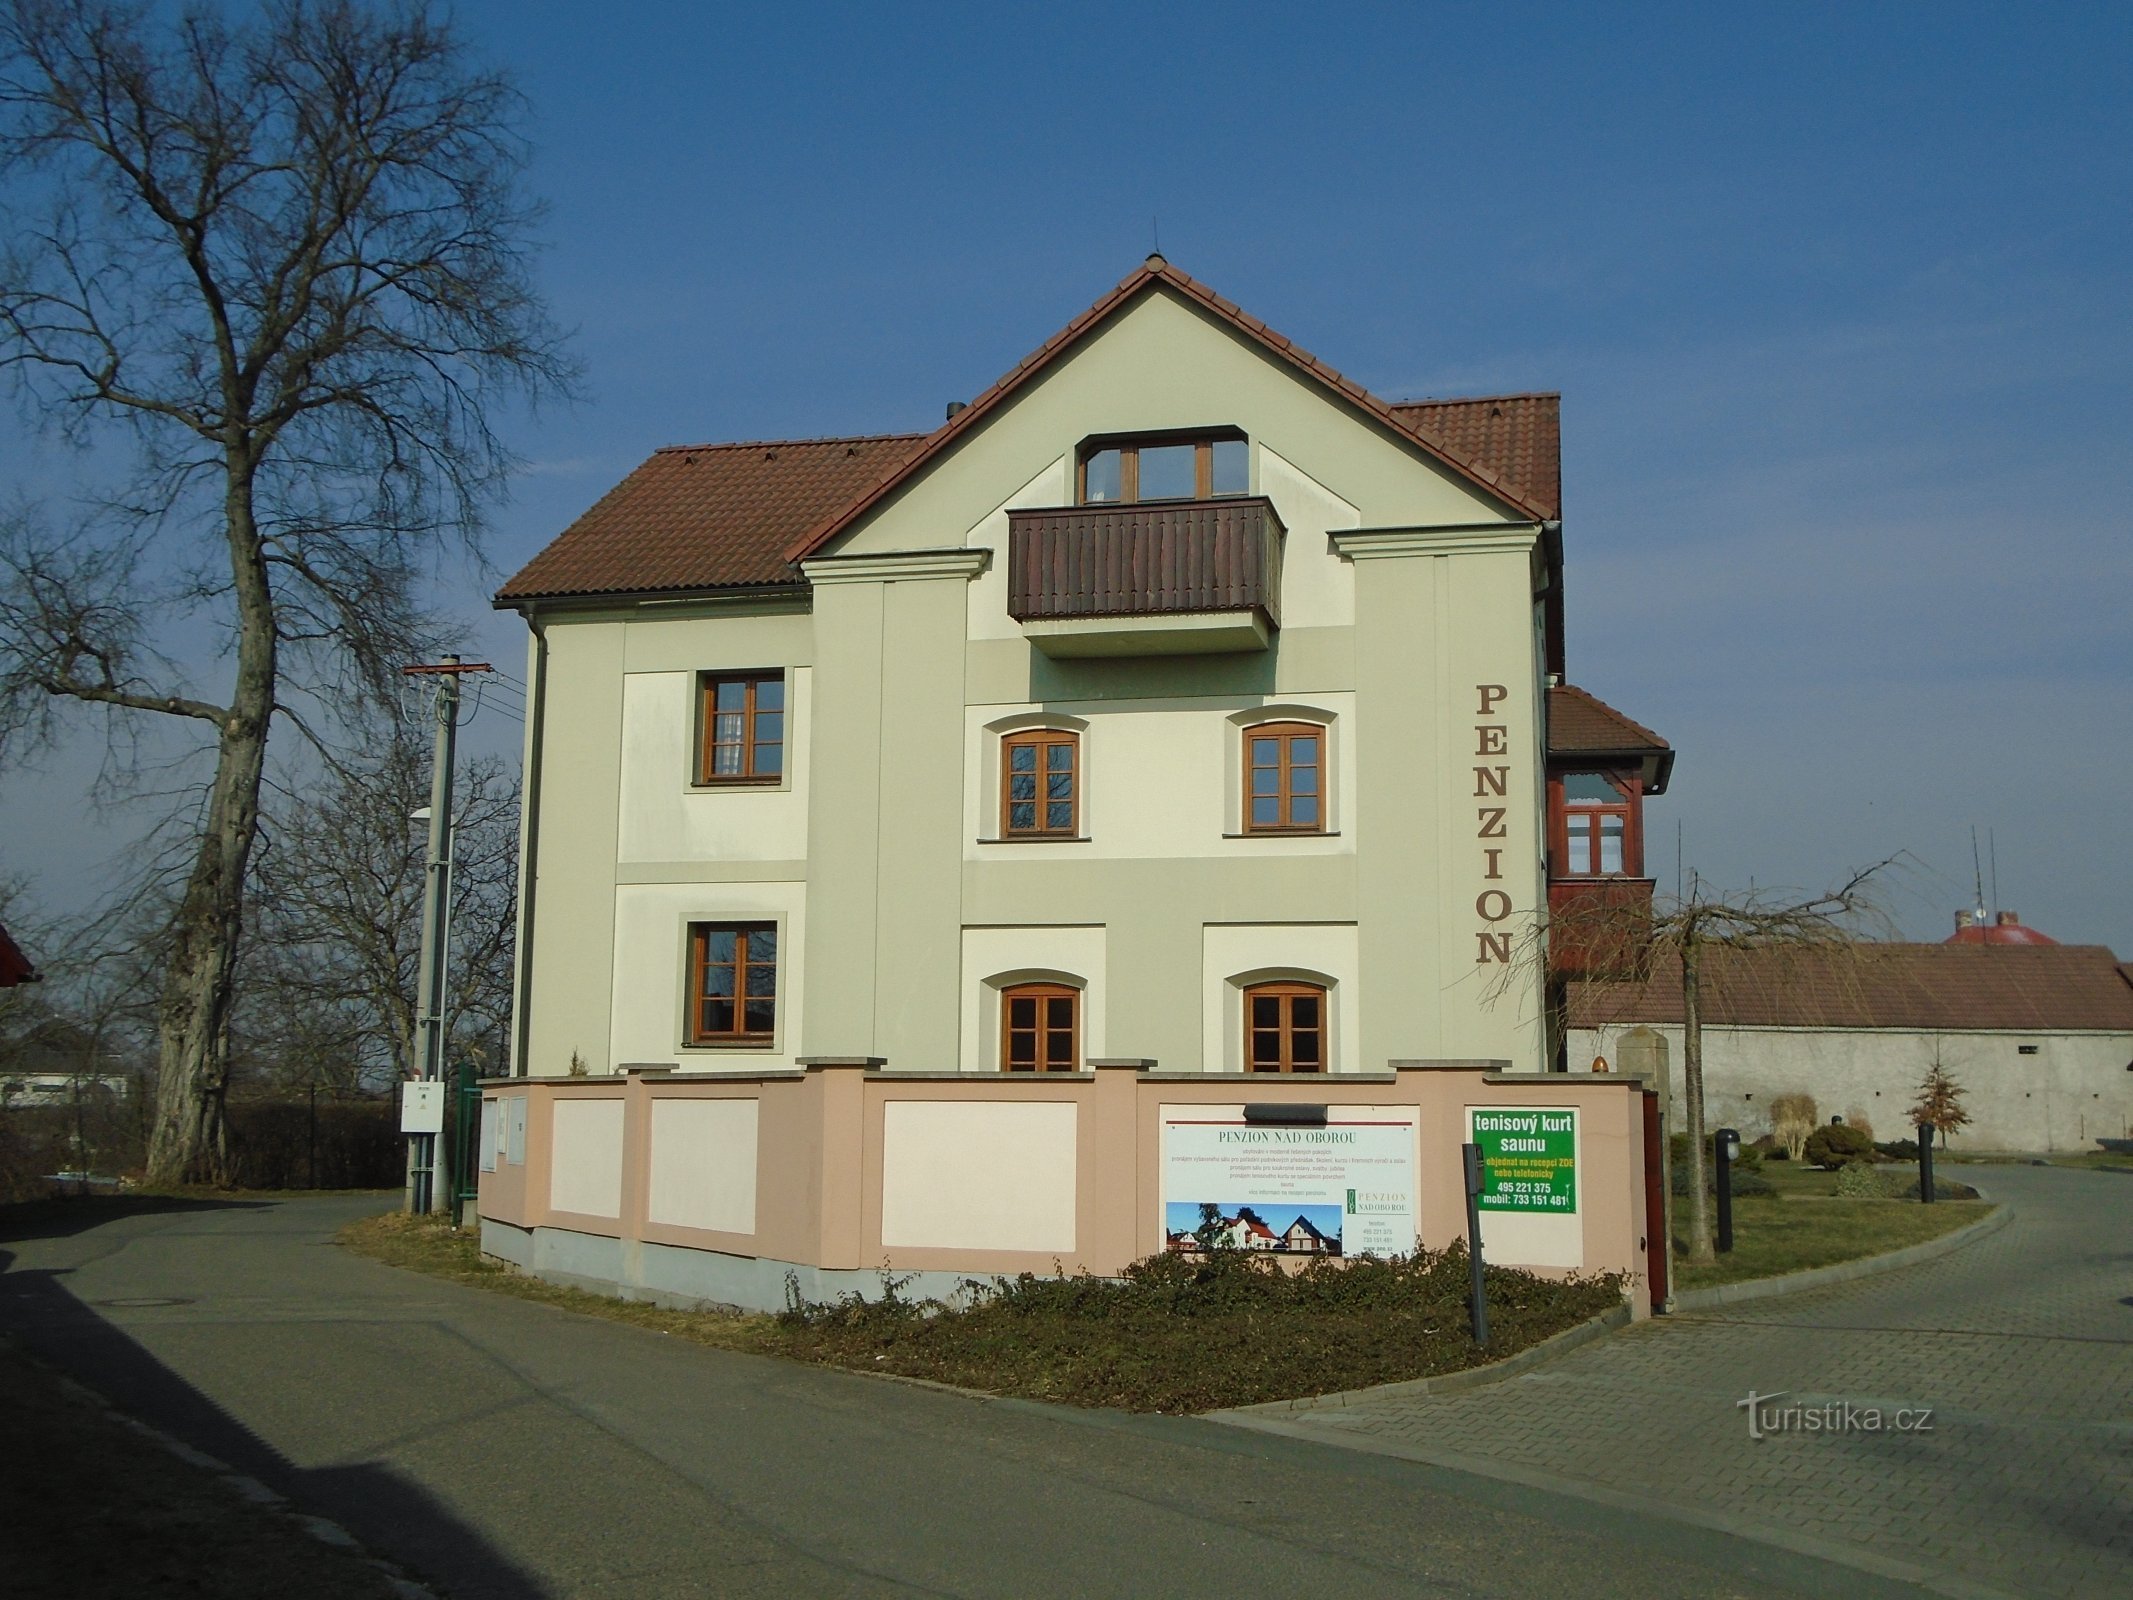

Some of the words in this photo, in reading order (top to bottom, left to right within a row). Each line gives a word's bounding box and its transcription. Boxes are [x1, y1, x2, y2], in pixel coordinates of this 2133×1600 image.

[1472, 684, 1513, 963] PENZION
[1475, 1114, 1538, 1135] tenisový
[1542, 1114, 1572, 1131] kurt
[1218, 1131, 1269, 1143] PENZION
[1274, 1131, 1302, 1144] NAD
[1305, 1132, 1357, 1144] OBOROU
[1500, 1138, 1546, 1152] saunu
[1486, 1157, 1518, 1168] objednat
[1530, 1158, 1557, 1168] recepci
[1559, 1158, 1574, 1167] ZDE
[1494, 1169, 1512, 1177] nebo
[1513, 1169, 1554, 1179] telefonicky
[1497, 1182, 1514, 1193] 495
[1515, 1182, 1532, 1193] 221
[1534, 1183, 1551, 1193] 375
[1358, 1193, 1407, 1201] PENZION
[1483, 1194, 1511, 1204] mobil:
[1513, 1194, 1530, 1205] 733
[1531, 1195, 1547, 1205] 151
[1550, 1195, 1566, 1206] 481
